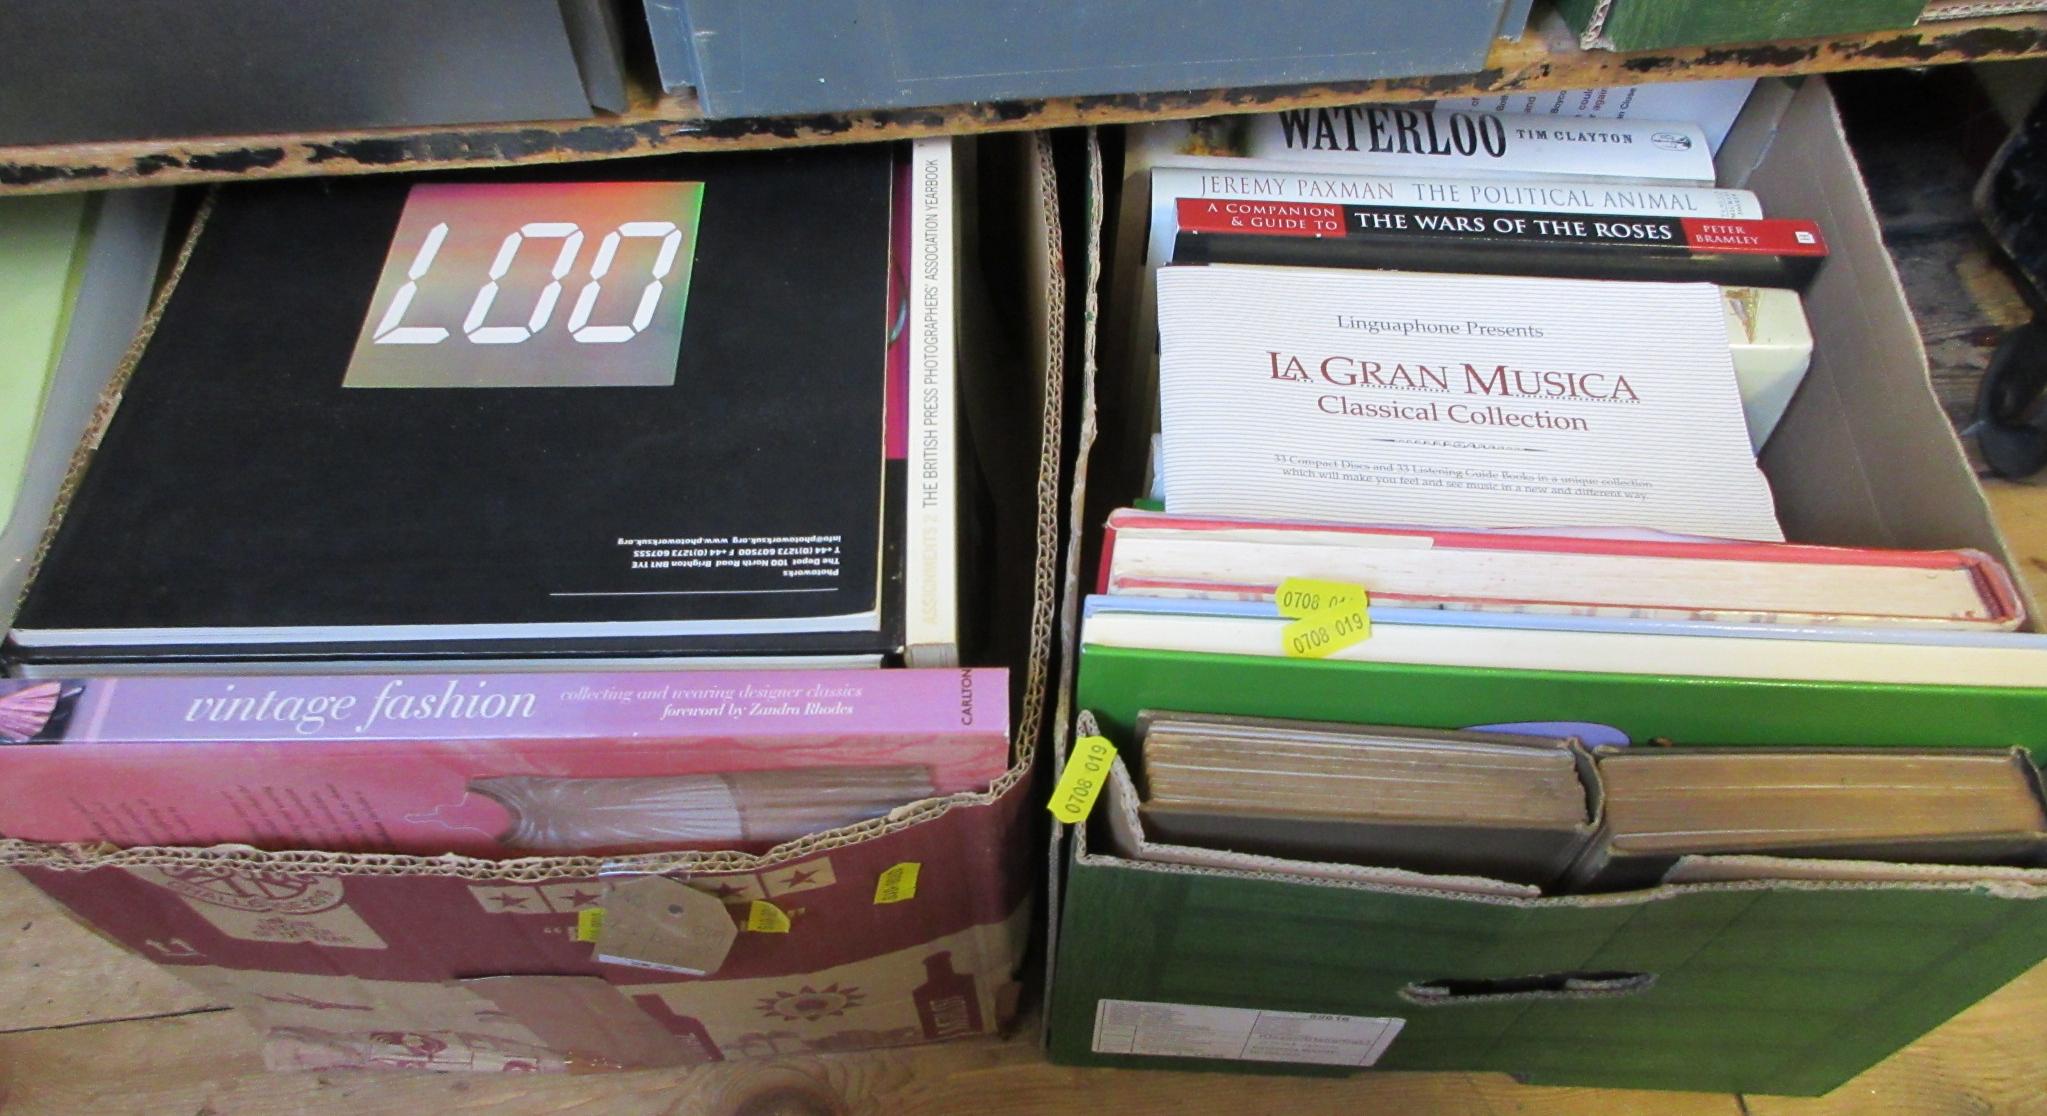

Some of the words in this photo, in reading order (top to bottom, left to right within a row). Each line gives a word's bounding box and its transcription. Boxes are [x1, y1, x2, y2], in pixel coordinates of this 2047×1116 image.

[1279, 106, 1507, 159] WATERLOO
[1516, 129, 1548, 140] TIM
[1553, 131, 1633, 145] CLAYTON
[925, 159, 939, 212] YEARBOOK
[1201, 176, 1285, 197] JEREMY
[1298, 180, 1394, 200] PAXMAN
[1411, 183, 1460, 202] THE
[1470, 185, 1594, 208] POLITICAL
[1604, 190, 1699, 212] ANIMAL
[1207, 203, 1218, 213] A
[1226, 204, 1335, 217] COMPANION
[1231, 216, 1244, 227] &
[1250, 217, 1307, 230] GUIDE
[1316, 220, 1338, 230] TO
[1354, 212, 1408, 229] THE
[1414, 215, 1486, 233] WARS
[1493, 217, 1526, 235] OF
[1529, 220, 1588, 238] THE
[1594, 222, 1674, 241] ROSES
[1702, 225, 1746, 236] PETER
[925, 213, 939, 280] ASSOCIATION
[1695, 234, 1760, 246] BRAMLEY
[1337, 315, 1460, 336] Linguaphone
[1467, 321, 1544, 338] Presents
[1266, 351, 1311, 381] LA
[1321, 356, 1449, 390] GRAN
[1460, 363, 1640, 401] MUSICA
[924, 388, 938, 426] PRESS
[1317, 394, 1438, 422] Classical
[1448, 404, 1590, 432] Collection
[923, 430, 938, 478] BRITISH
[1290, 455, 1337, 469] Compact
[1341, 460, 1371, 471] Discs
[1373, 463, 1393, 473] and
[1413, 465, 1464, 479] Listening
[1465, 470, 1499, 480] Guide
[1502, 471, 1535, 482] Books
[1601, 479, 1653, 489] collection
[1282, 467, 1315, 478] which
[1319, 471, 1339, 481] will
[1343, 473, 1372, 483] make
[1376, 476, 1397, 487] you
[1400, 475, 1419, 486] feel
[1422, 477, 1443, 488] and
[1446, 480, 1463, 489] see
[1466, 482, 1500, 491] music
[1501, 483, 1512, 491] in
[1525, 485, 1548, 494] new
[1551, 486, 1571, 495] and
[1575, 487, 1622, 498] different
[923, 482, 938, 508] THE
[617, 536, 729, 546] www.photoworksuk.org
[732, 534, 841, 545] info@photoworksuk.org
[633, 550, 670, 559] 607555
[672, 548, 708, 558] (0)1273
[710, 548, 727, 558] +44
[738, 548, 776, 557] 607500
[777, 546, 813, 556] (0)1273
[814, 545, 832, 554] +44
[632, 560, 649, 569] 1YE
[651, 561, 669, 569] BN1
[671, 559, 711, 569] Brighton
[716, 559, 740, 568] Road
[742, 558, 768, 568] North
[771, 558, 788, 567] 100
[792, 557, 821, 567] Depot
[821, 557, 840, 566] The
[783, 568, 839, 577] Photoworks
[1283, 591, 1321, 610] 0708
[1293, 626, 1331, 654] 0708
[1335, 612, 1364, 637] 019
[559, 686, 633, 704] collecting
[637, 684, 668, 700] and
[672, 685, 735, 702] wearing
[739, 683, 802, 701] designer
[805, 683, 864, 699] classics
[961, 669, 973, 726] CARLTON
[184, 684, 357, 735] vintage
[354, 679, 537, 733] fashion
[660, 703, 724, 721] foreword
[728, 703, 747, 719] by
[750, 702, 800, 717] Zandra
[804, 701, 854, 715] Rhodes
[1065, 778, 1093, 814] 0708
[1085, 744, 1107, 772] 019
